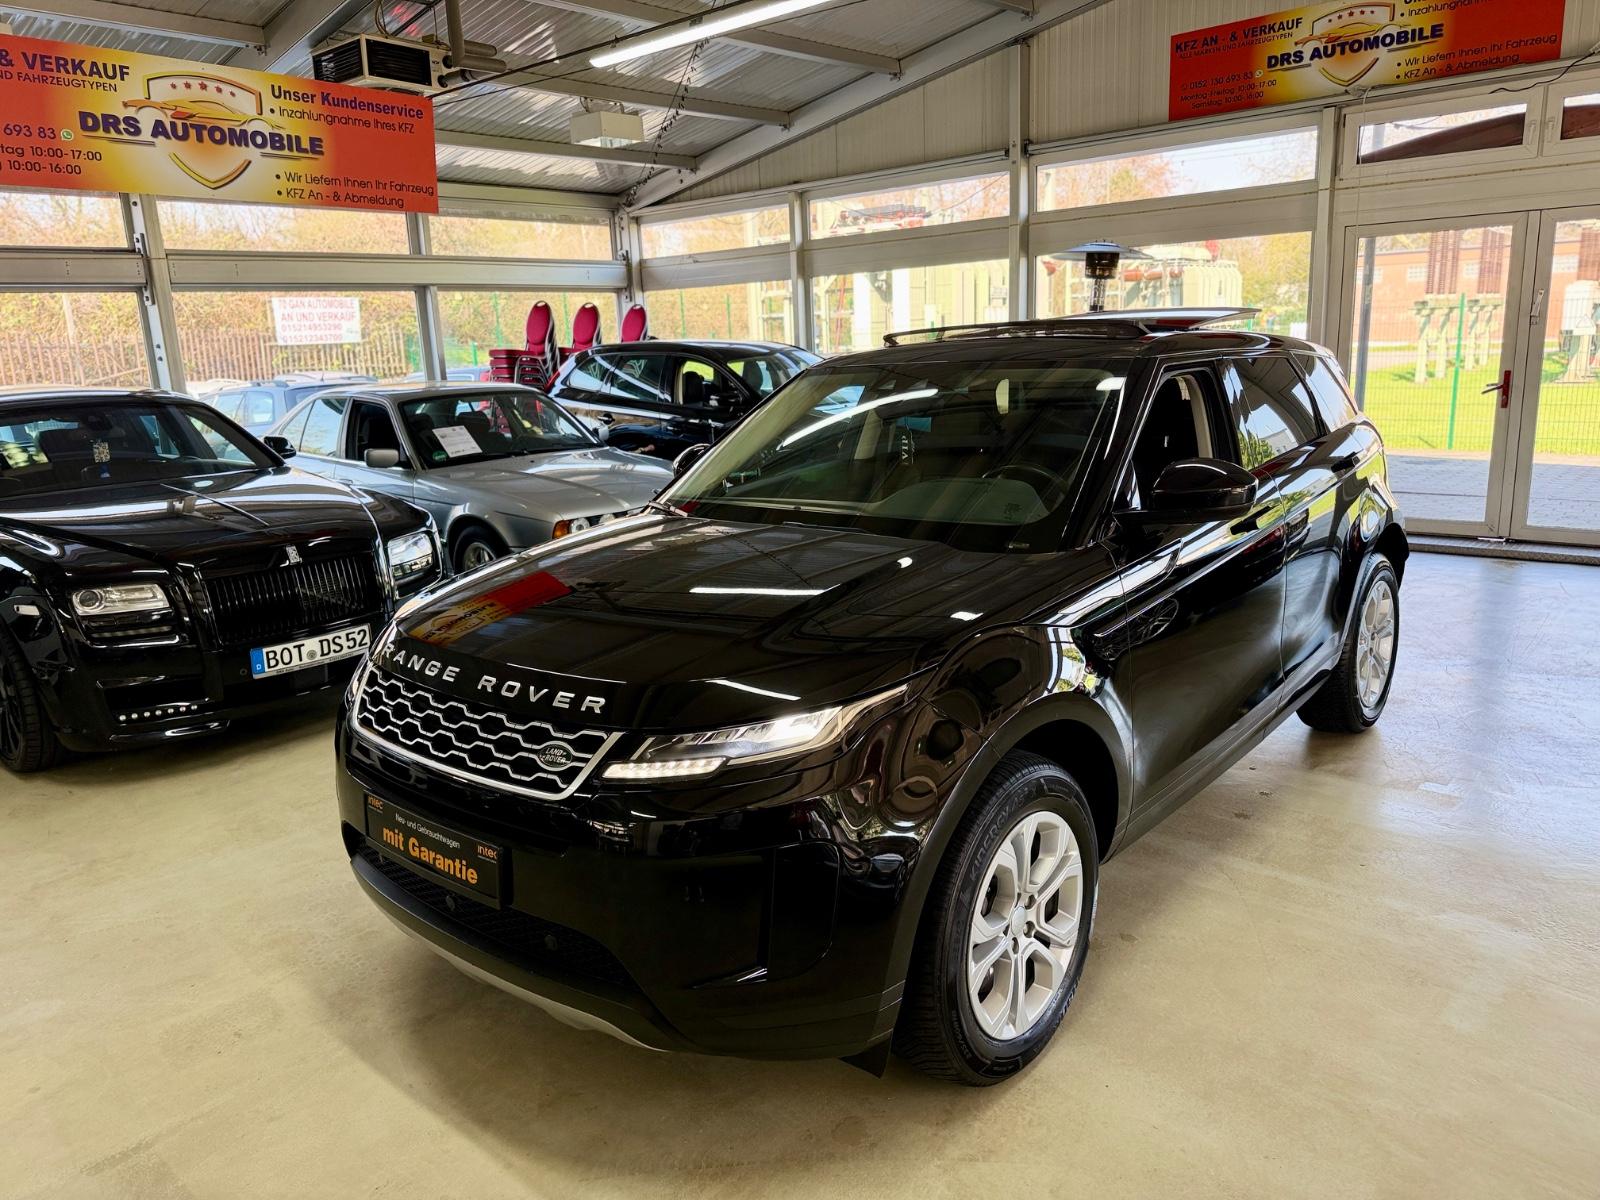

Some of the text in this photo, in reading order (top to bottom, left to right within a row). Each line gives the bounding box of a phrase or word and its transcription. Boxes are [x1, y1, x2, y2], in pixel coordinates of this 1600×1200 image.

[1175, 40, 1198, 54] KFZ
[1201, 34, 1218, 48] AN
[1229, 31, 1238, 42] &
[1243, 17, 1303, 38] VERKAUF
[1237, 32, 1293, 49] FAHRZEUGTYPEN
[1266, 23, 1445, 70] DRS AUTOMOBILE
[1405, 34, 1557, 67] Wir Liefern Ihnen Ihr Fahrzeug
[21, 51, 130, 81] VERKAUF
[1404, 68, 1420, 79] KFZ
[1422, 67, 1437, 76] An
[1445, 64, 1452, 73] &
[1456, 54, 1519, 70] Abmeldung
[17, 73, 118, 92] FAHRZEUGTYPEN
[271, 85, 424, 119] Unser Kundenservice
[3, 124, 56, 140] 693 83
[78, 111, 325, 155] DRS AUTOMOBILE
[279, 106, 415, 134] Inzahlungnahme Ihres KFZ
[284, 171, 434, 196] Wir Liefern Ihnen Ihr Fahrzeug
[286, 188, 304, 200] KFZ
[308, 189, 323, 201] An
[333, 192, 341, 202] &
[344, 192, 404, 208] Abmeldung
[281, 311, 357, 322] AN UND VERKAUF
[307, 298, 355, 310] AUTOMOBILE
[265, 643, 305, 669] BOT
[381, 642, 606, 714] RANGE ROVER
[543, 744, 567, 764] LAND ROVER
[395, 813, 460, 849] Neu- und Gebrauchtwagen
[383, 827, 478, 884] mit Garantie
